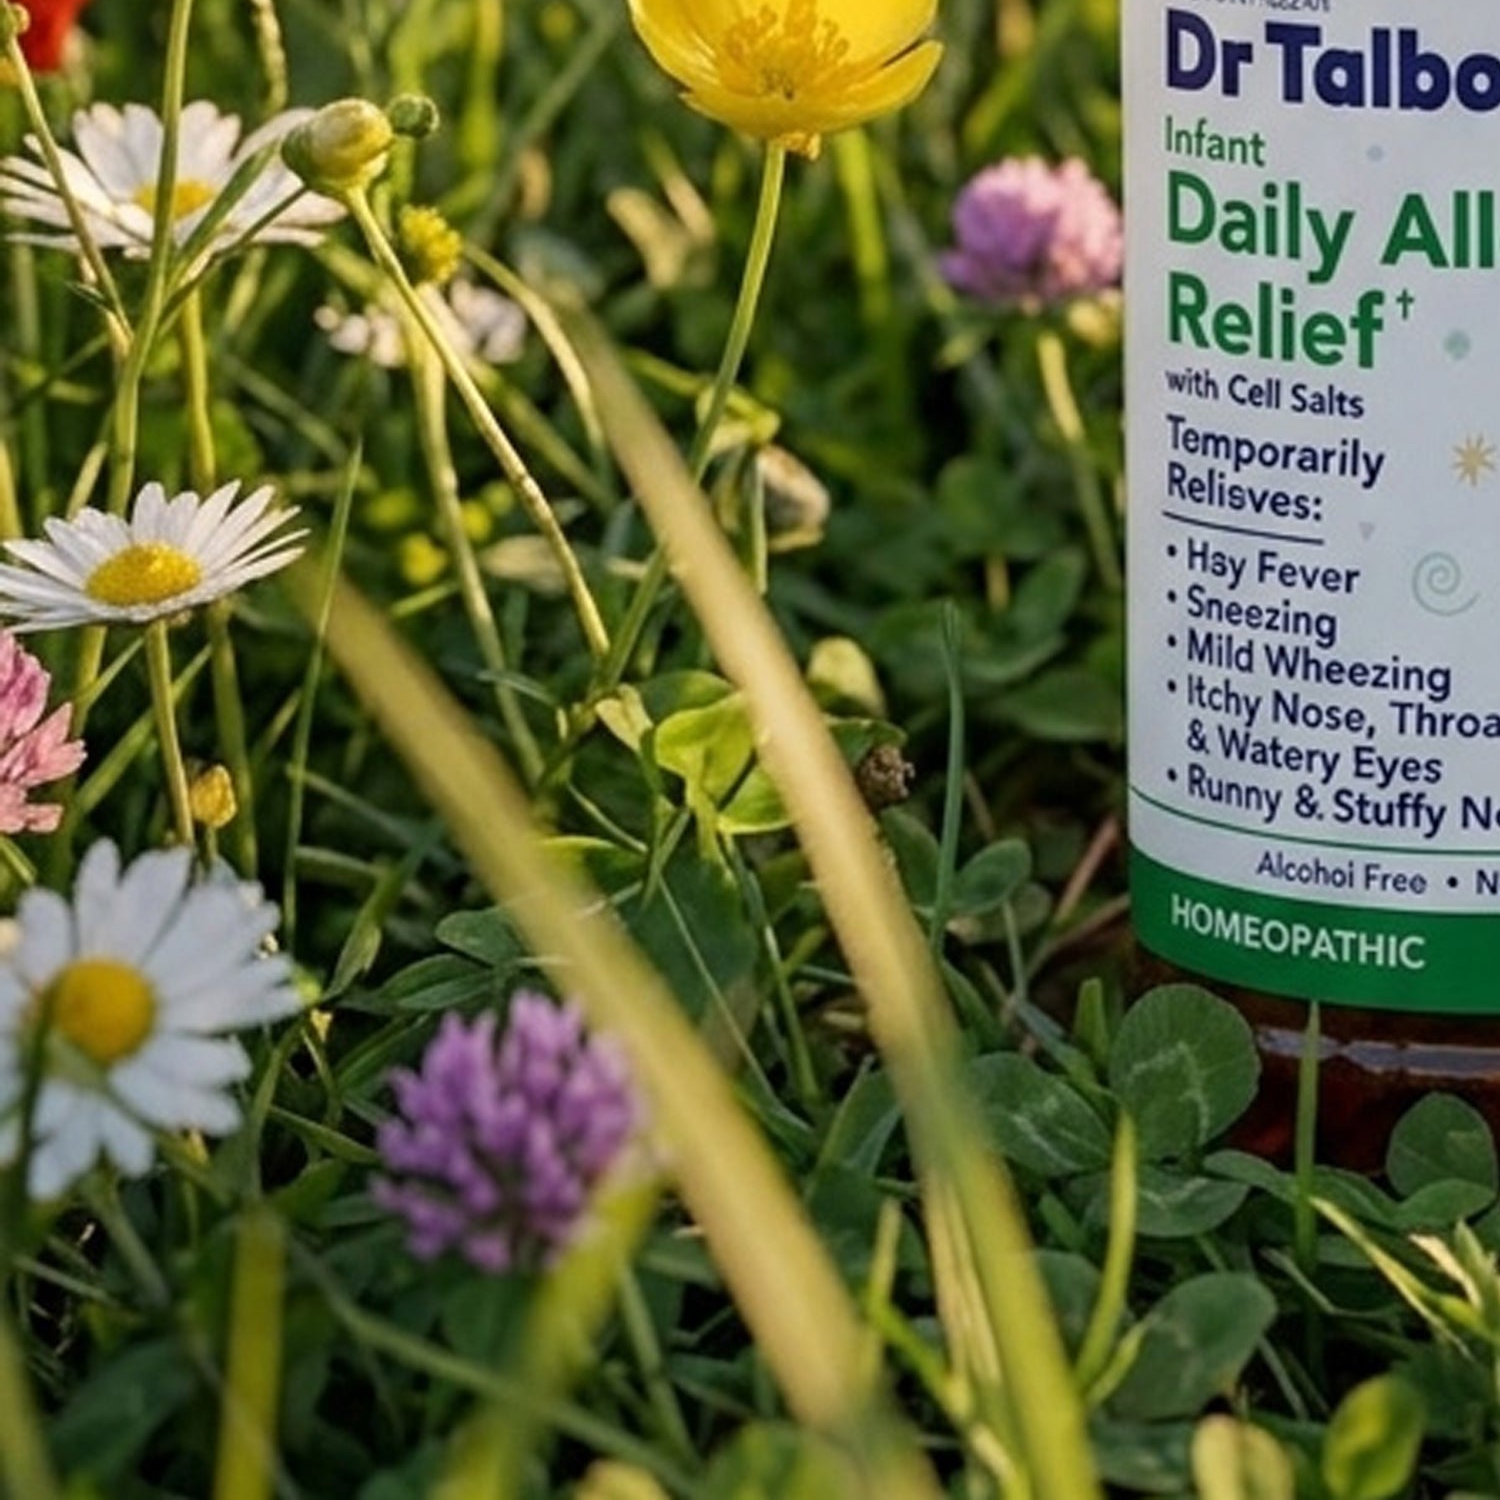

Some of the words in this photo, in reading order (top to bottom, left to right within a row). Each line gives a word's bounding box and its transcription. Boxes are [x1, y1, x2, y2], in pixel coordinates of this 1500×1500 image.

[1166, 8, 1253, 96] Dr
[1165, 115, 1266, 167] Infant
[1168, 170, 1355, 285] Daily
[1166, 368, 1219, 400] with
[1228, 373, 1281, 411] Cell
[1291, 383, 1365, 418] Salts
[1166, 413, 1385, 490] Temporarily
[1258, 550, 1361, 593] Fever
[1187, 583, 1337, 650] Sneezing
[1187, 628, 1254, 673] Mild
[1264, 644, 1451, 702] Wheezing
[1187, 674, 1262, 727] Itchy
[1272, 690, 1377, 739] Nose,
[1187, 718, 1210, 755] &
[1218, 726, 1340, 785] Watery
[1353, 746, 1443, 789] Eyes
[1187, 763, 1282, 823] Runny
[1333, 789, 1446, 838] Stuffy
[1364, 863, 1428, 894] Free
[1171, 893, 1426, 970] HOMEOPATHIC
